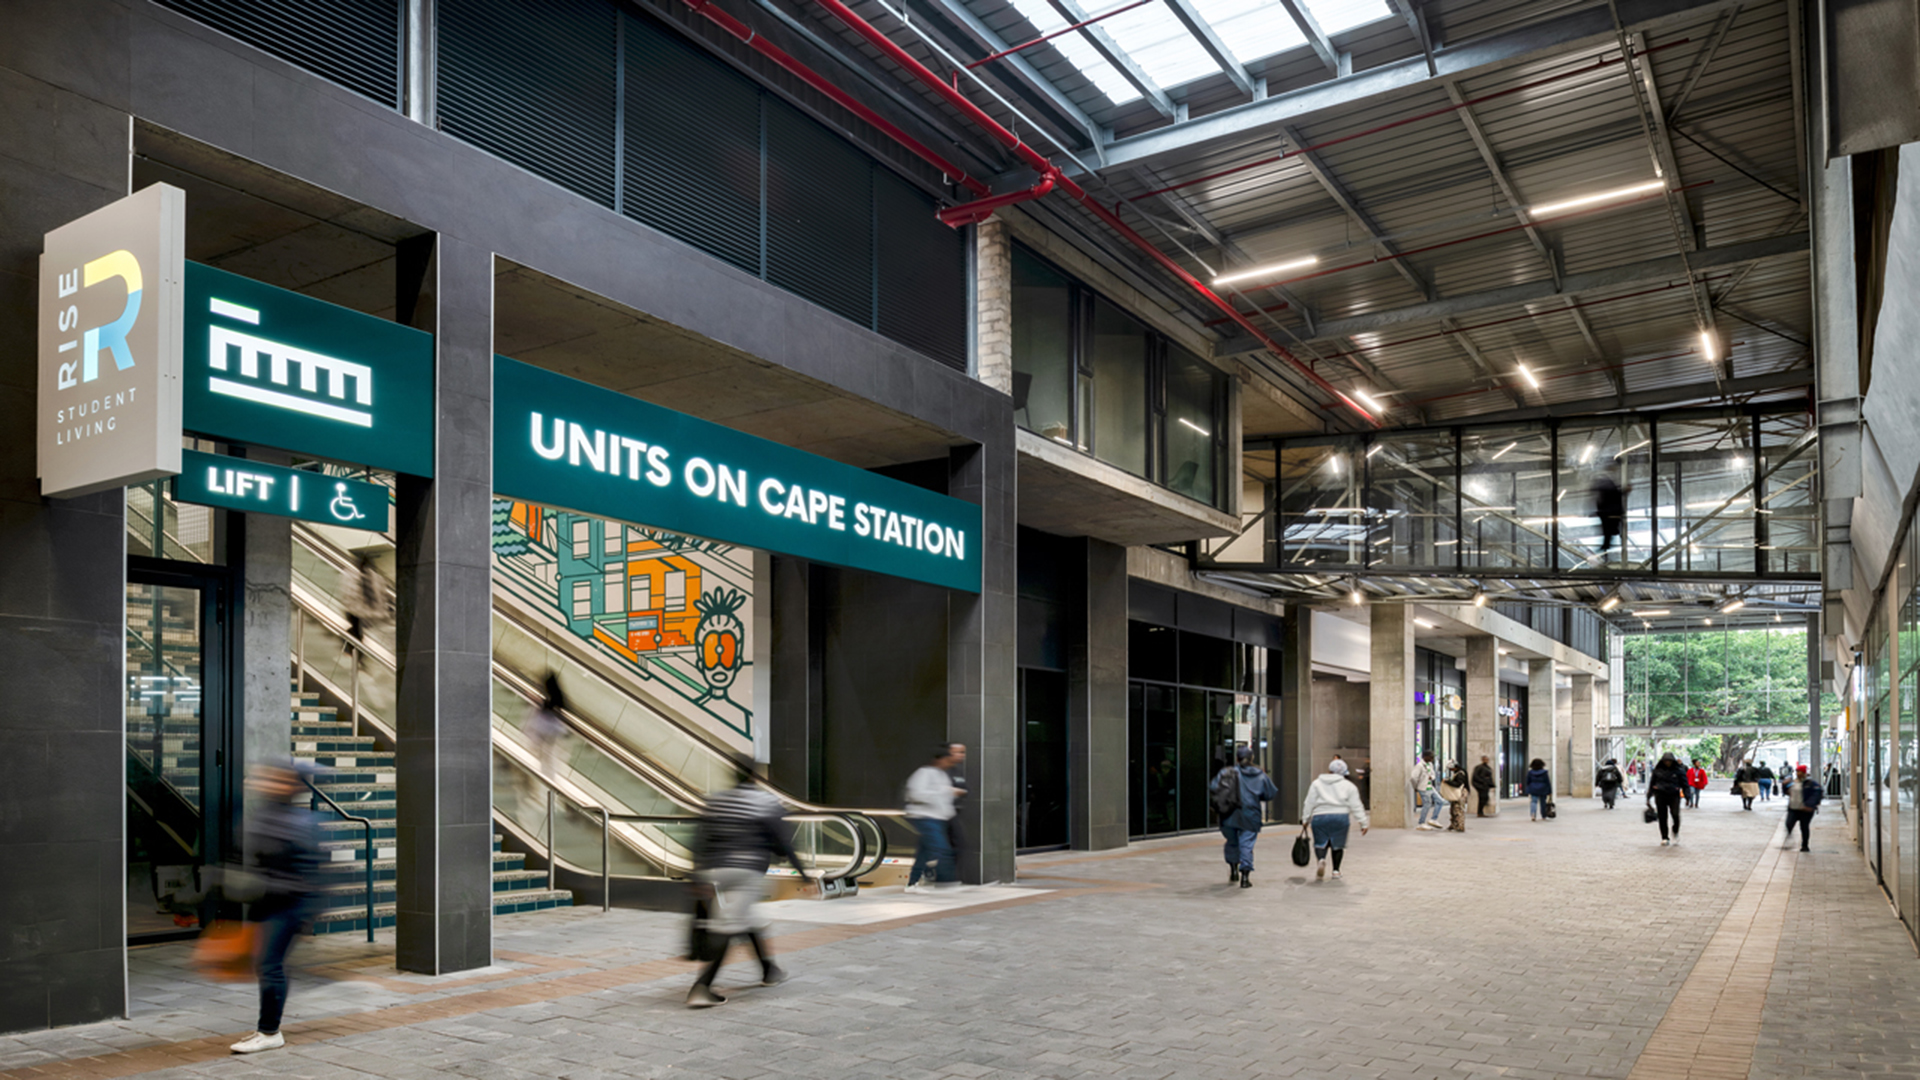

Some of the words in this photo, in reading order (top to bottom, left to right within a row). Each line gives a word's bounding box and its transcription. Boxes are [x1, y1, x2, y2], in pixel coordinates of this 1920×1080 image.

[58, 268, 79, 391] RISE
[83, 249, 143, 383] R
[57, 387, 136, 424] STUDENT
[57, 416, 117, 445] LIVING
[207, 466, 274, 501] LIFT
[531, 411, 672, 487] UNITS
[684, 456, 747, 507] ON
[758, 477, 846, 531] CAPE
[854, 502, 965, 561] STATION
